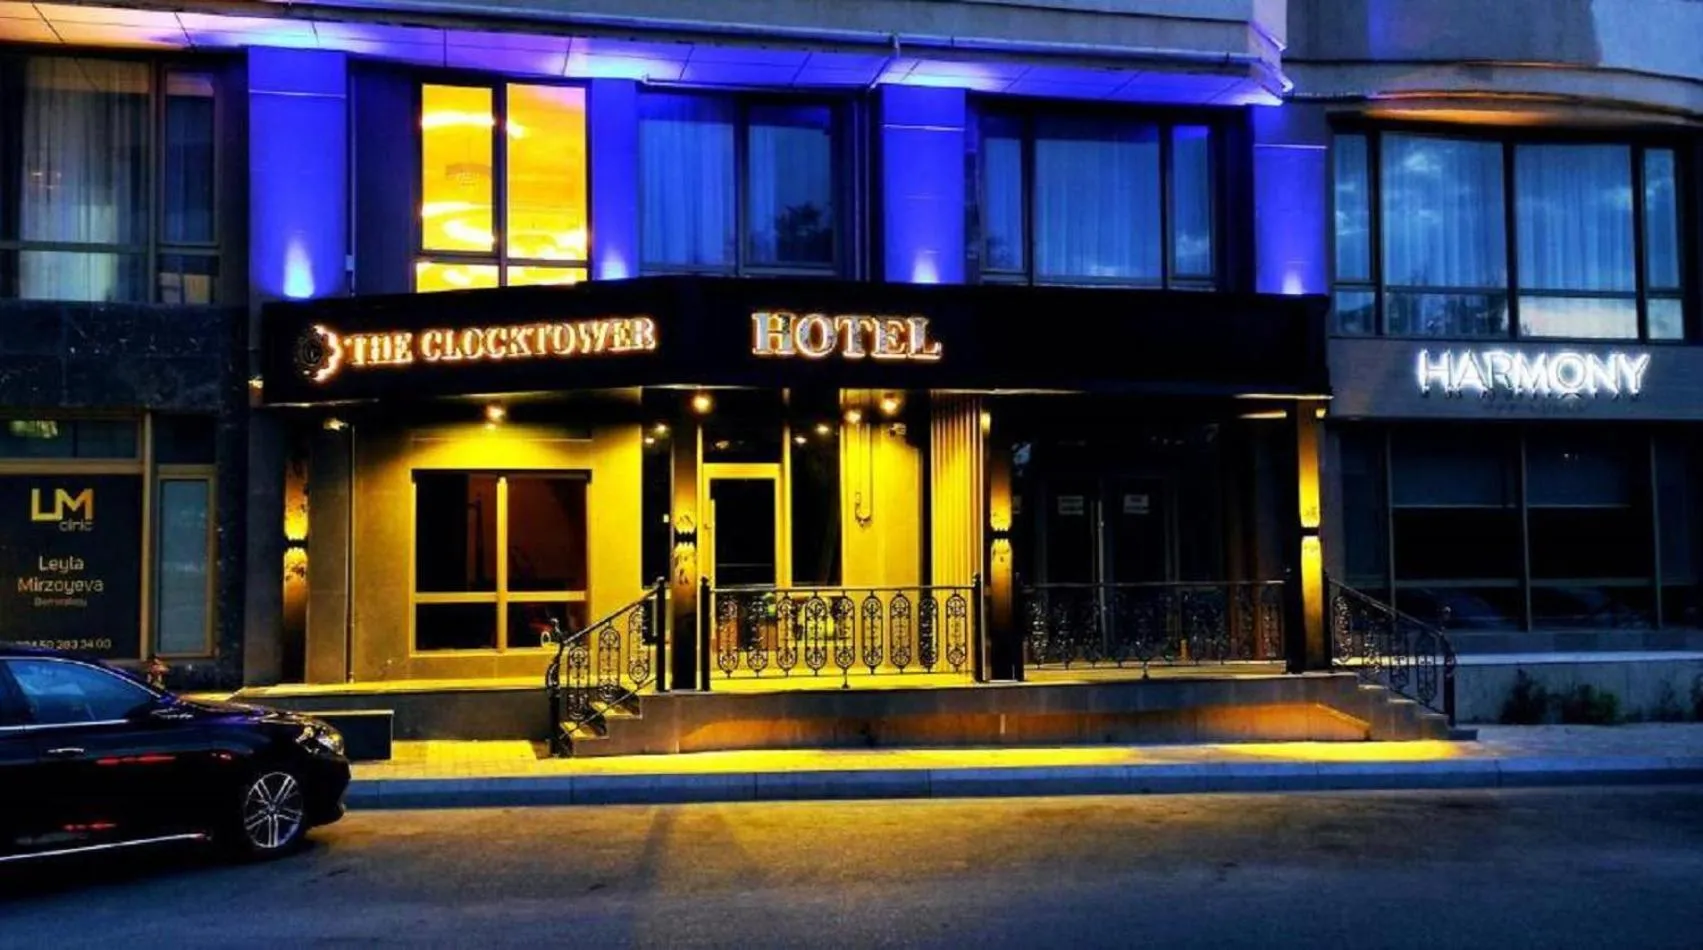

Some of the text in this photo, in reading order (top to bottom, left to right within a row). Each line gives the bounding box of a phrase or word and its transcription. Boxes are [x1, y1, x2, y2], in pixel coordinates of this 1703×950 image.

[345, 317, 657, 365] THE CLOCKTOWER
[751, 312, 943, 361] HOTEL
[1417, 349, 1650, 395] HARMONY
[31, 487, 95, 521] LM
[39, 555, 85, 574] Leyla
[18, 577, 105, 595] Mirzoyeva
